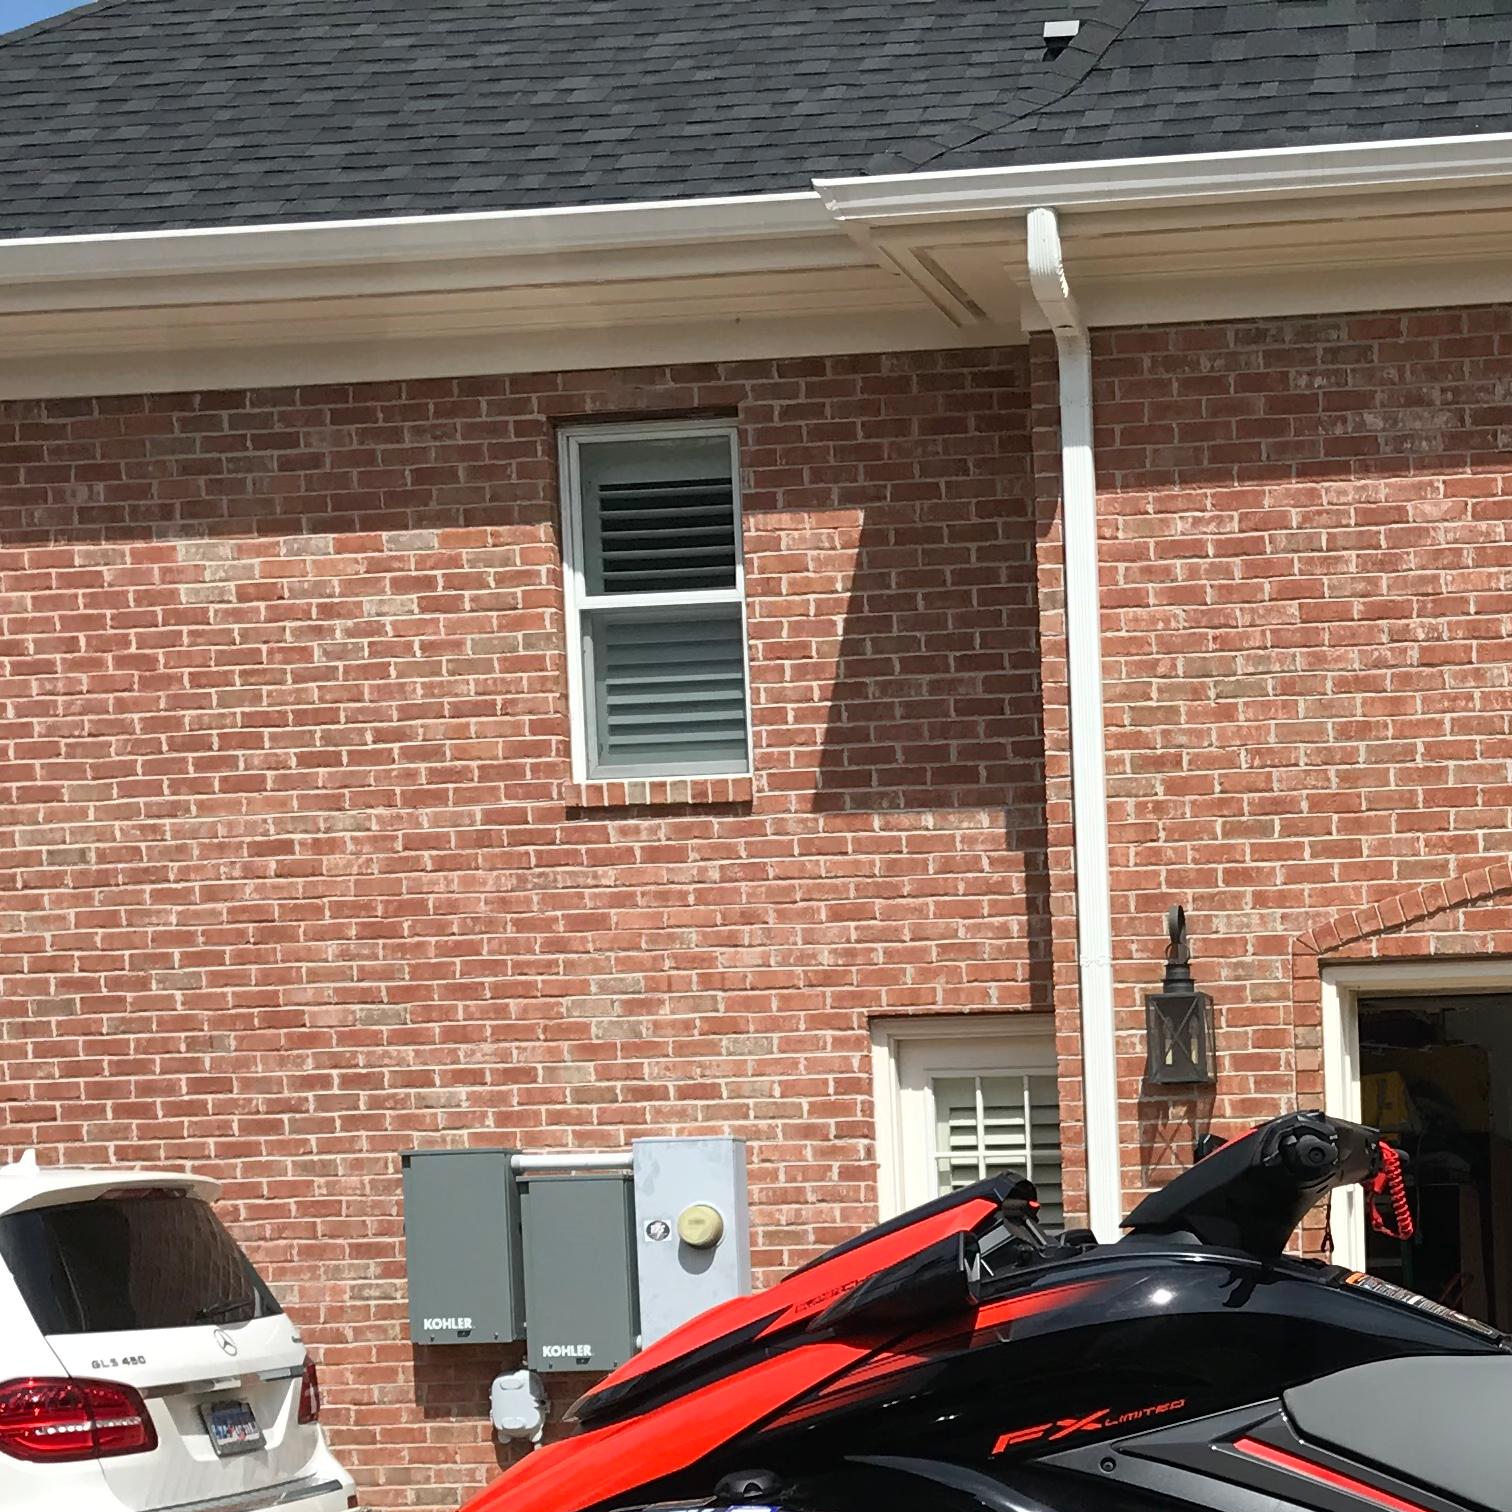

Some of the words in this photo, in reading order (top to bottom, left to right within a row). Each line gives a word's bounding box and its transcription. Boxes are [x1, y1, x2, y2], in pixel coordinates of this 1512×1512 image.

[424, 1317, 472, 1330] KOHLER
[542, 1344, 592, 1358] KOHLER
[91, 1357, 119, 1369] GLS
[991, 1408, 1110, 1455] FX
[1105, 1398, 1186, 1427] LIMITED
